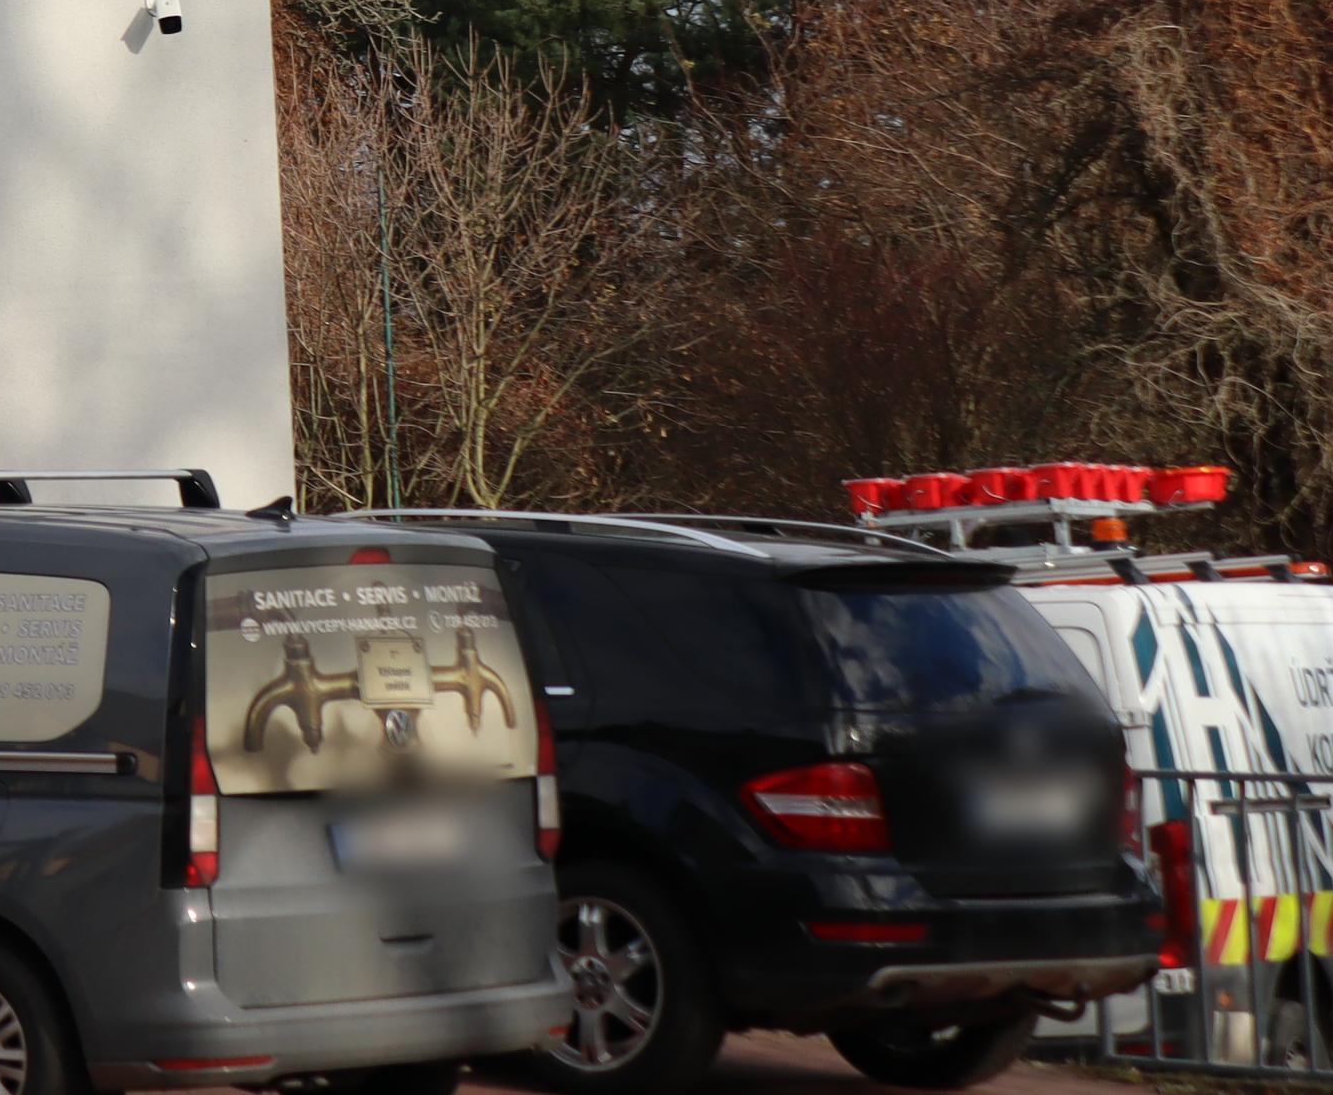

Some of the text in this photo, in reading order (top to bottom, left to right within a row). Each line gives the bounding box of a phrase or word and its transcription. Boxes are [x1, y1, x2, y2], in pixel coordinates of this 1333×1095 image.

[253, 588, 337, 610] SANITACE
[355, 586, 408, 605] SERVIS
[16, 618, 85, 638] SERVIS
